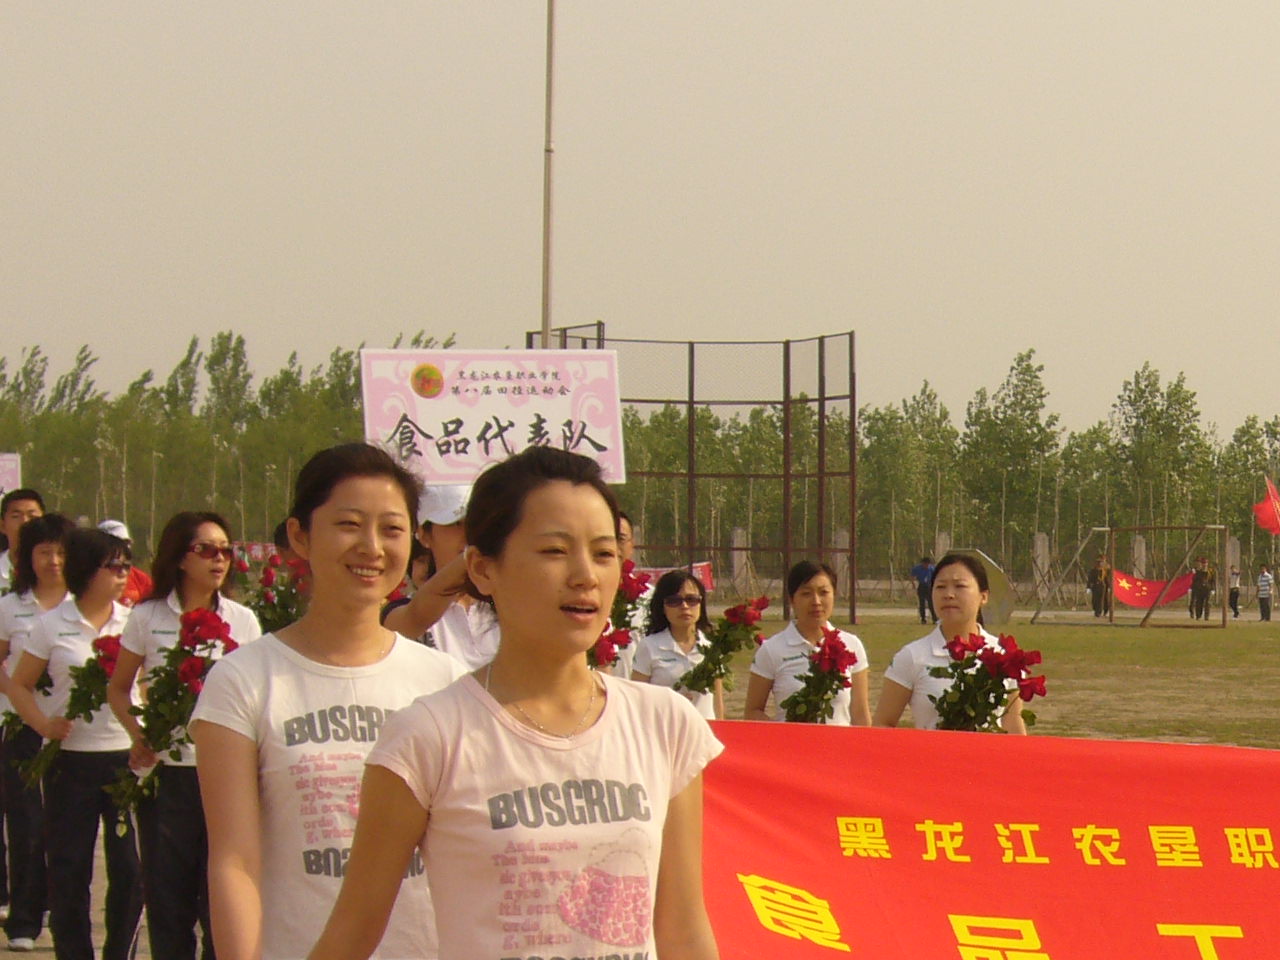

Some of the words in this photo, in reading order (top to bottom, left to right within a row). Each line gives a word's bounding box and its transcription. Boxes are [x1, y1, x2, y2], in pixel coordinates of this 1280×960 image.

[387, 413, 608, 457] 食品代表队
[283, 704, 395, 747] BUSGR
